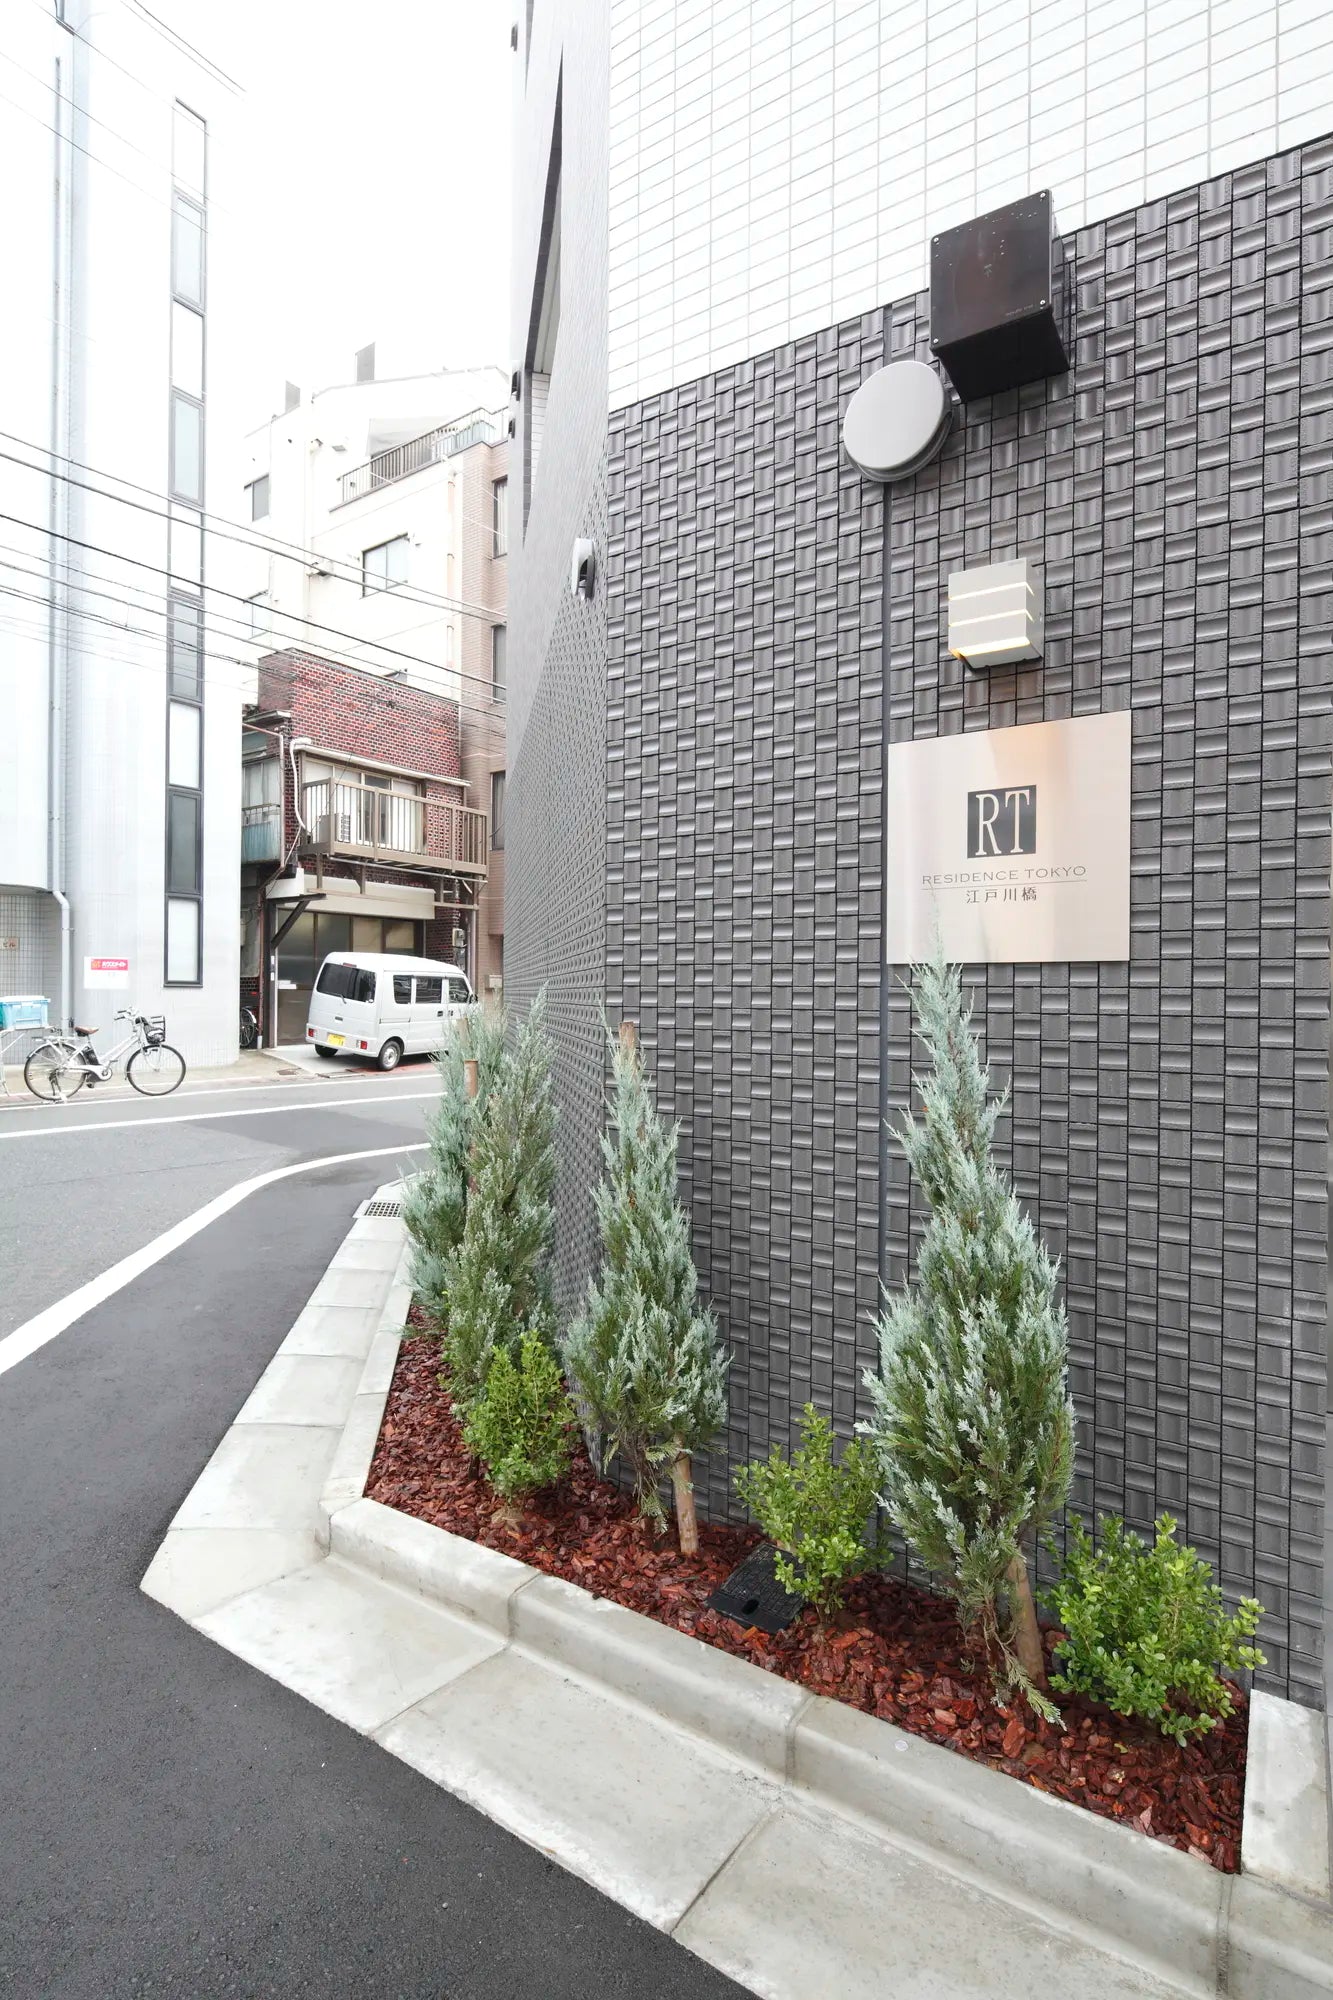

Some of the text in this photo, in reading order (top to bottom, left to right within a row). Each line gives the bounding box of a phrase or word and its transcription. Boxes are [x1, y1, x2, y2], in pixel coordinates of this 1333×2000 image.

[975, 789, 1031, 856] RT
[922, 865, 1087, 885] RESIDENCE TOKYO
[966, 887, 1038, 904] 江戸川橋
